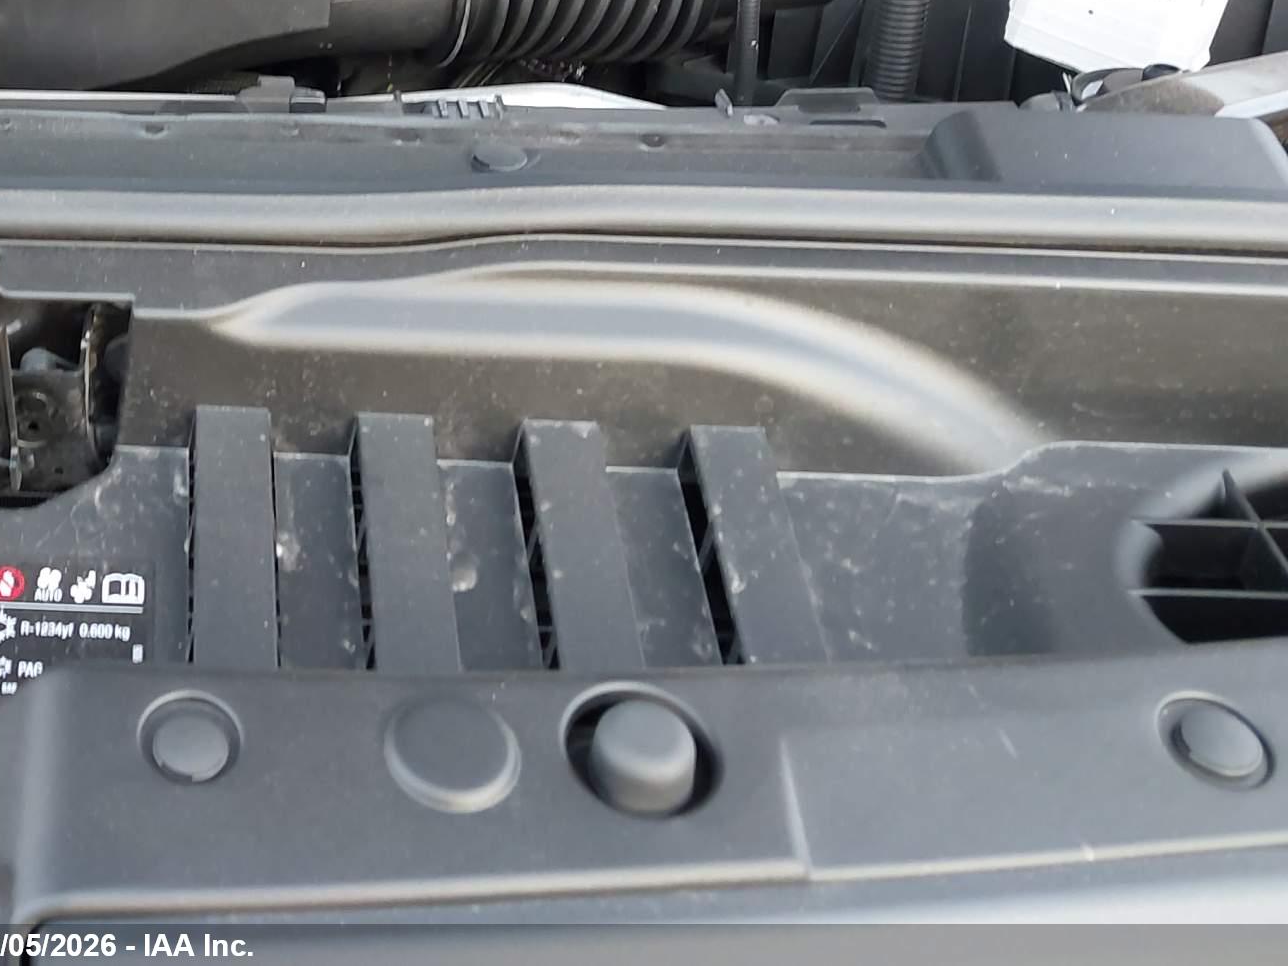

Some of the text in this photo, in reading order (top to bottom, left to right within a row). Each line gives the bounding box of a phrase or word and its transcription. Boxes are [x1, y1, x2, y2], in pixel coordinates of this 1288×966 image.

[34, 588, 63, 603] AUTO
[20, 620, 131, 642] R-1234yf 0.600 kg
